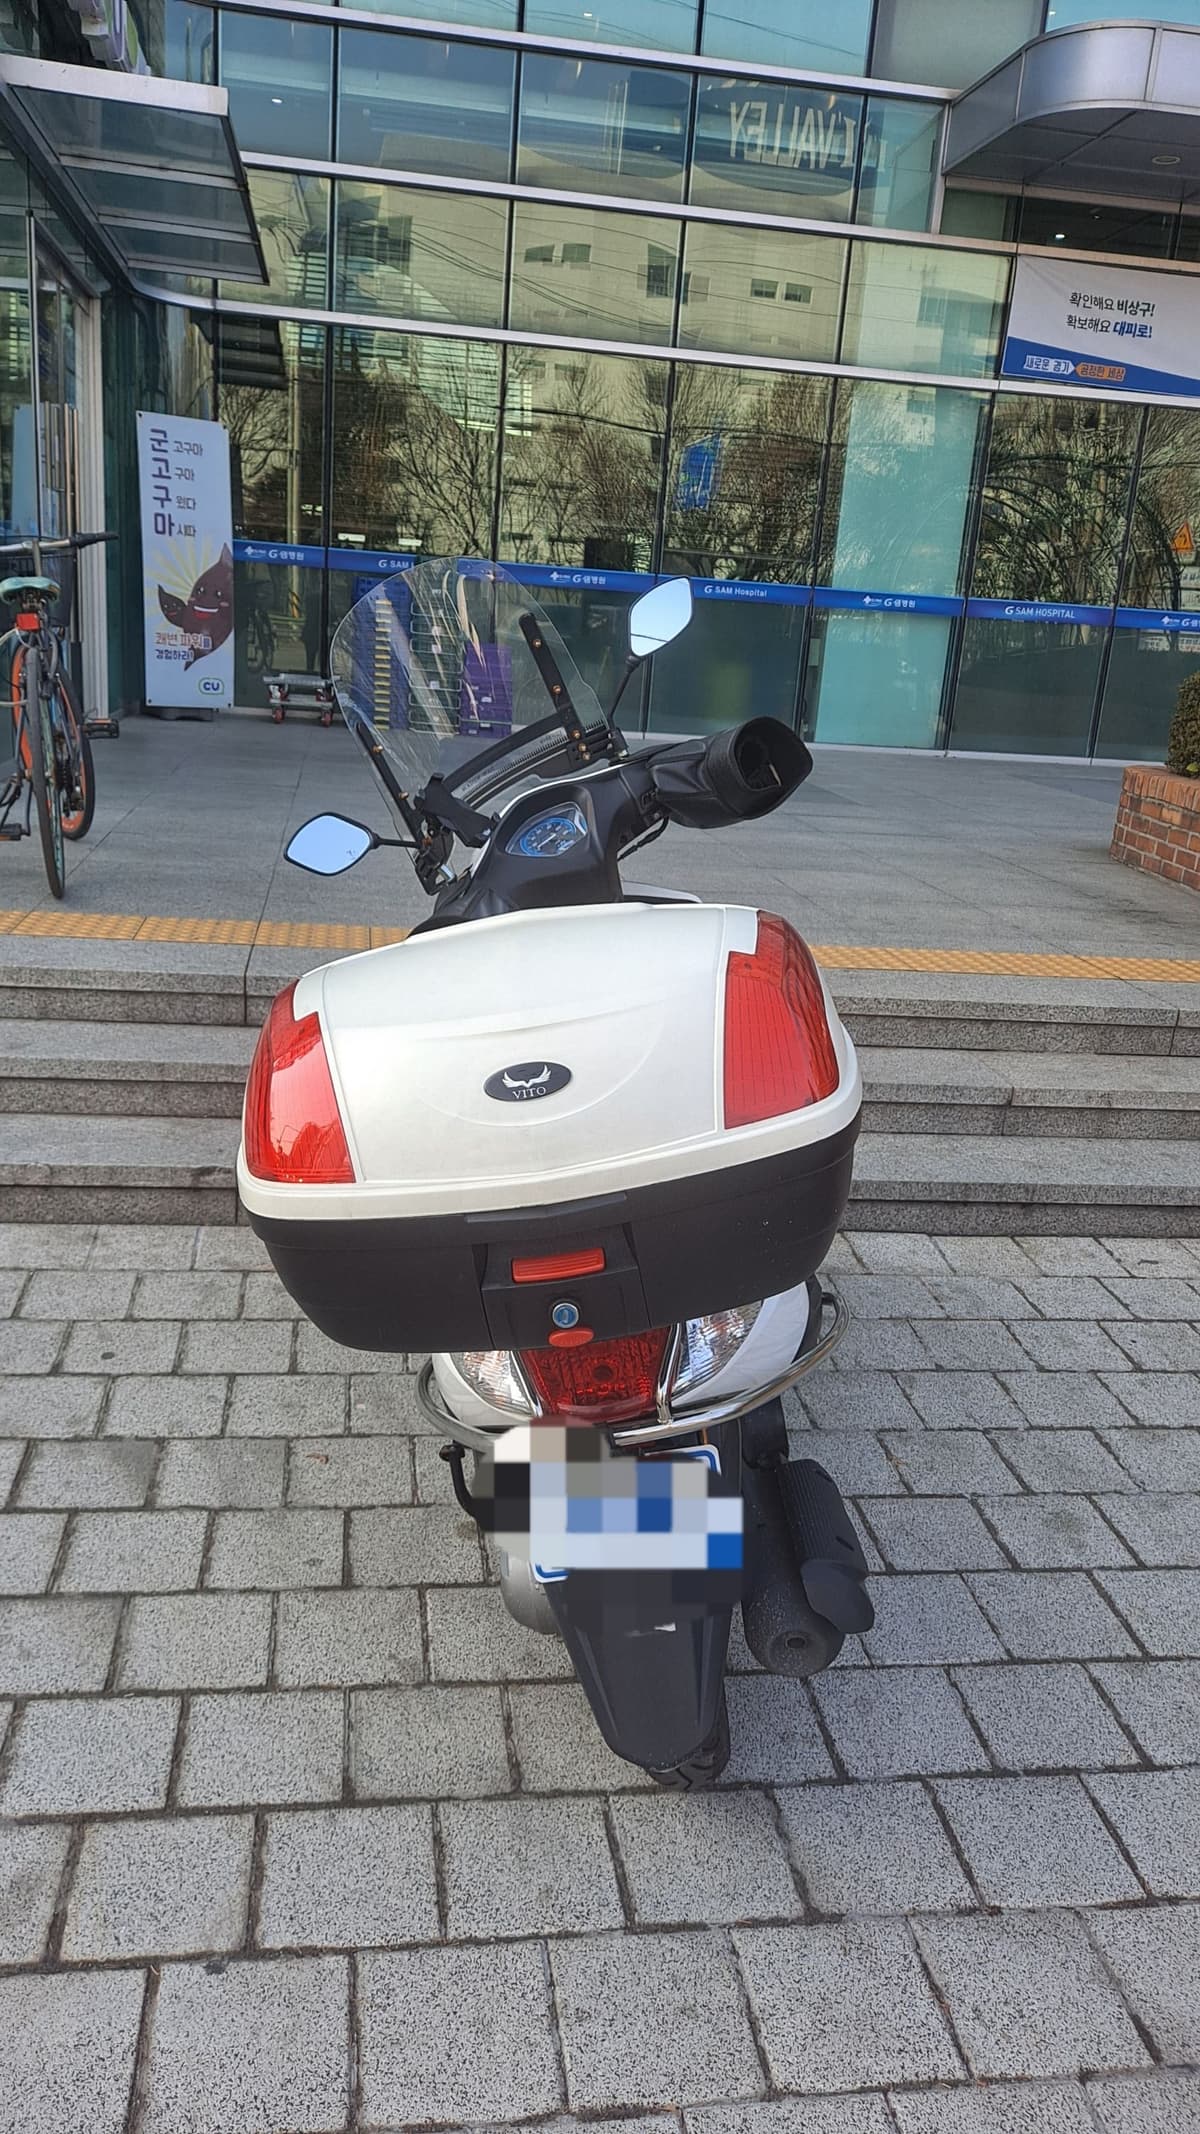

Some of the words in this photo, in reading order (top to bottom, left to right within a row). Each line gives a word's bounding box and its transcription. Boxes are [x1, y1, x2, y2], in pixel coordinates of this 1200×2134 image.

[1069, 292, 1114, 311] 확인해요
[1117, 299, 1155, 317] 비상구!
[1066, 315, 1111, 333] 확보해요
[1113, 321, 1153, 338] 대피로!
[1026, 355, 1050, 371] 새로운
[1053, 358, 1070, 373] 경기
[1080, 364, 1105, 377] 공정한
[149, 428, 169, 453] 군
[173, 440, 203, 456] 고구마
[152, 457, 172, 480] 고
[174, 467, 195, 481] 구마
[152, 485, 172, 509] 구
[154, 512, 175, 537] 마
[714, 586, 733, 595] SAM
[734, 588, 768, 598] Hospital
[1015, 607, 1034, 617] SAM
[1035, 608, 1075, 619] HOSPITAL
[203, 681, 220, 691] CU
[512, 1086, 547, 1099] VITO
